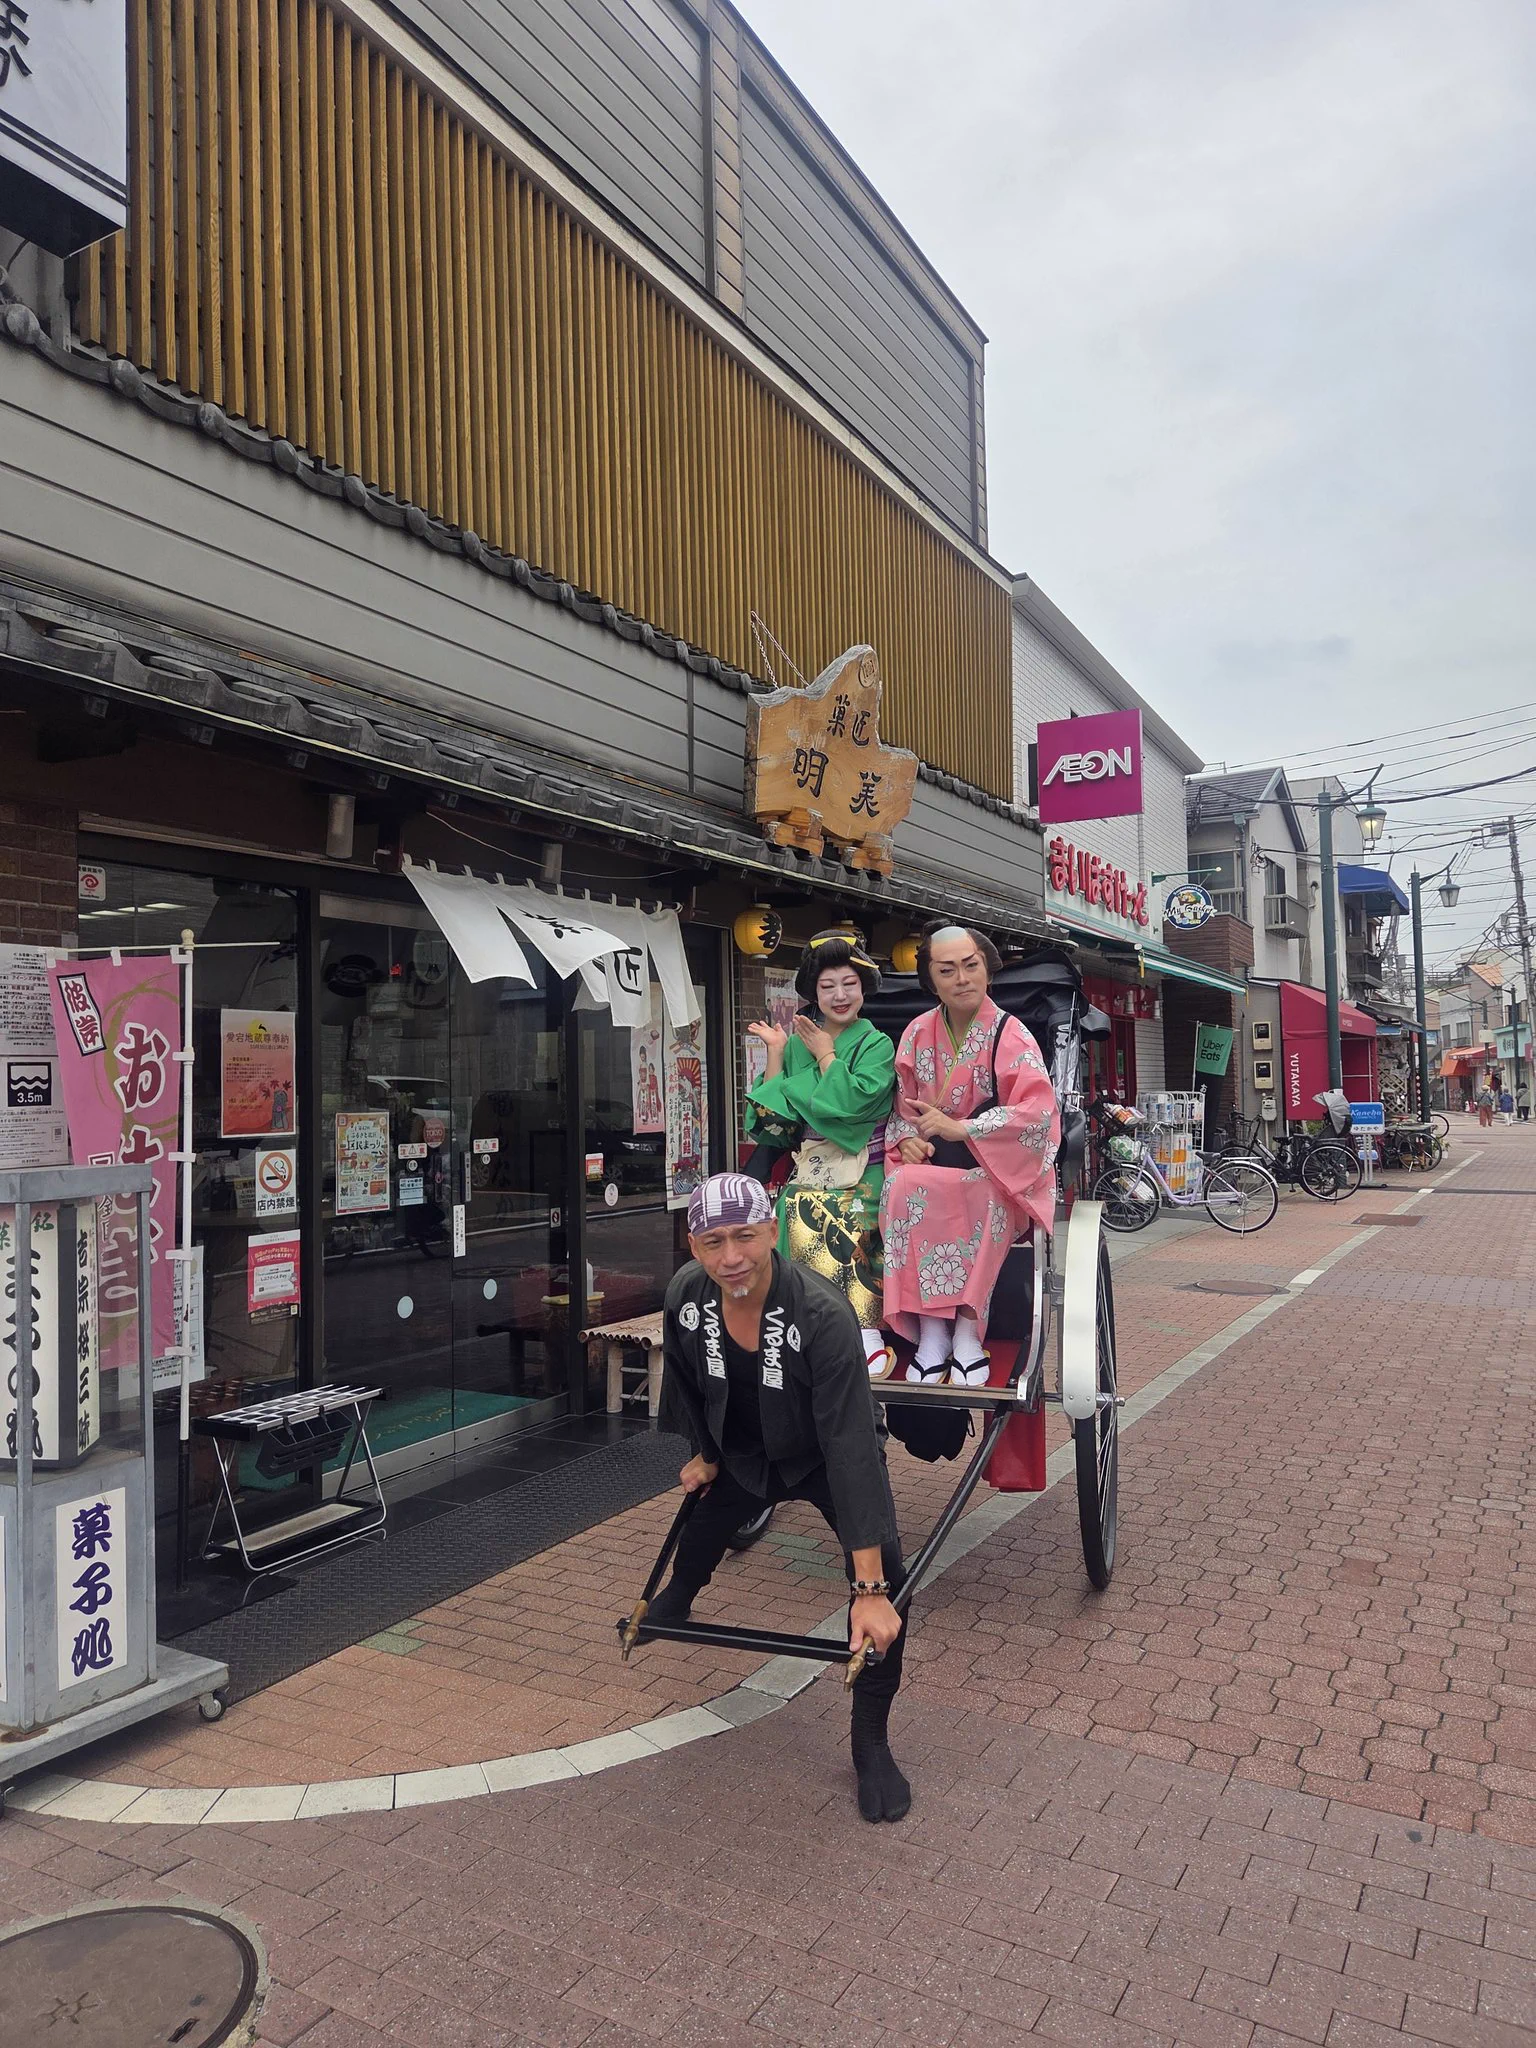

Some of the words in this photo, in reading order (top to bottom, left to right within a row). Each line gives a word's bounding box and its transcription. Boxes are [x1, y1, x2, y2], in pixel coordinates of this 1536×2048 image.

[792, 748, 882, 818] 明美
[1048, 835, 1150, 927] まいばすけっと
[611, 946, 644, 997] 匠
[64, 979, 100, 1048] 彼岸
[1200, 1049, 1221, 1062] Eats
[1202, 1039, 1224, 1052] Uber
[17, 1092, 43, 1103] 3.5m
[1290, 1052, 1301, 1107] YUTAKAYA
[257, 1196, 295, 1211] 店内禁煙
[69, 1502, 114, 1677] 菓子処
